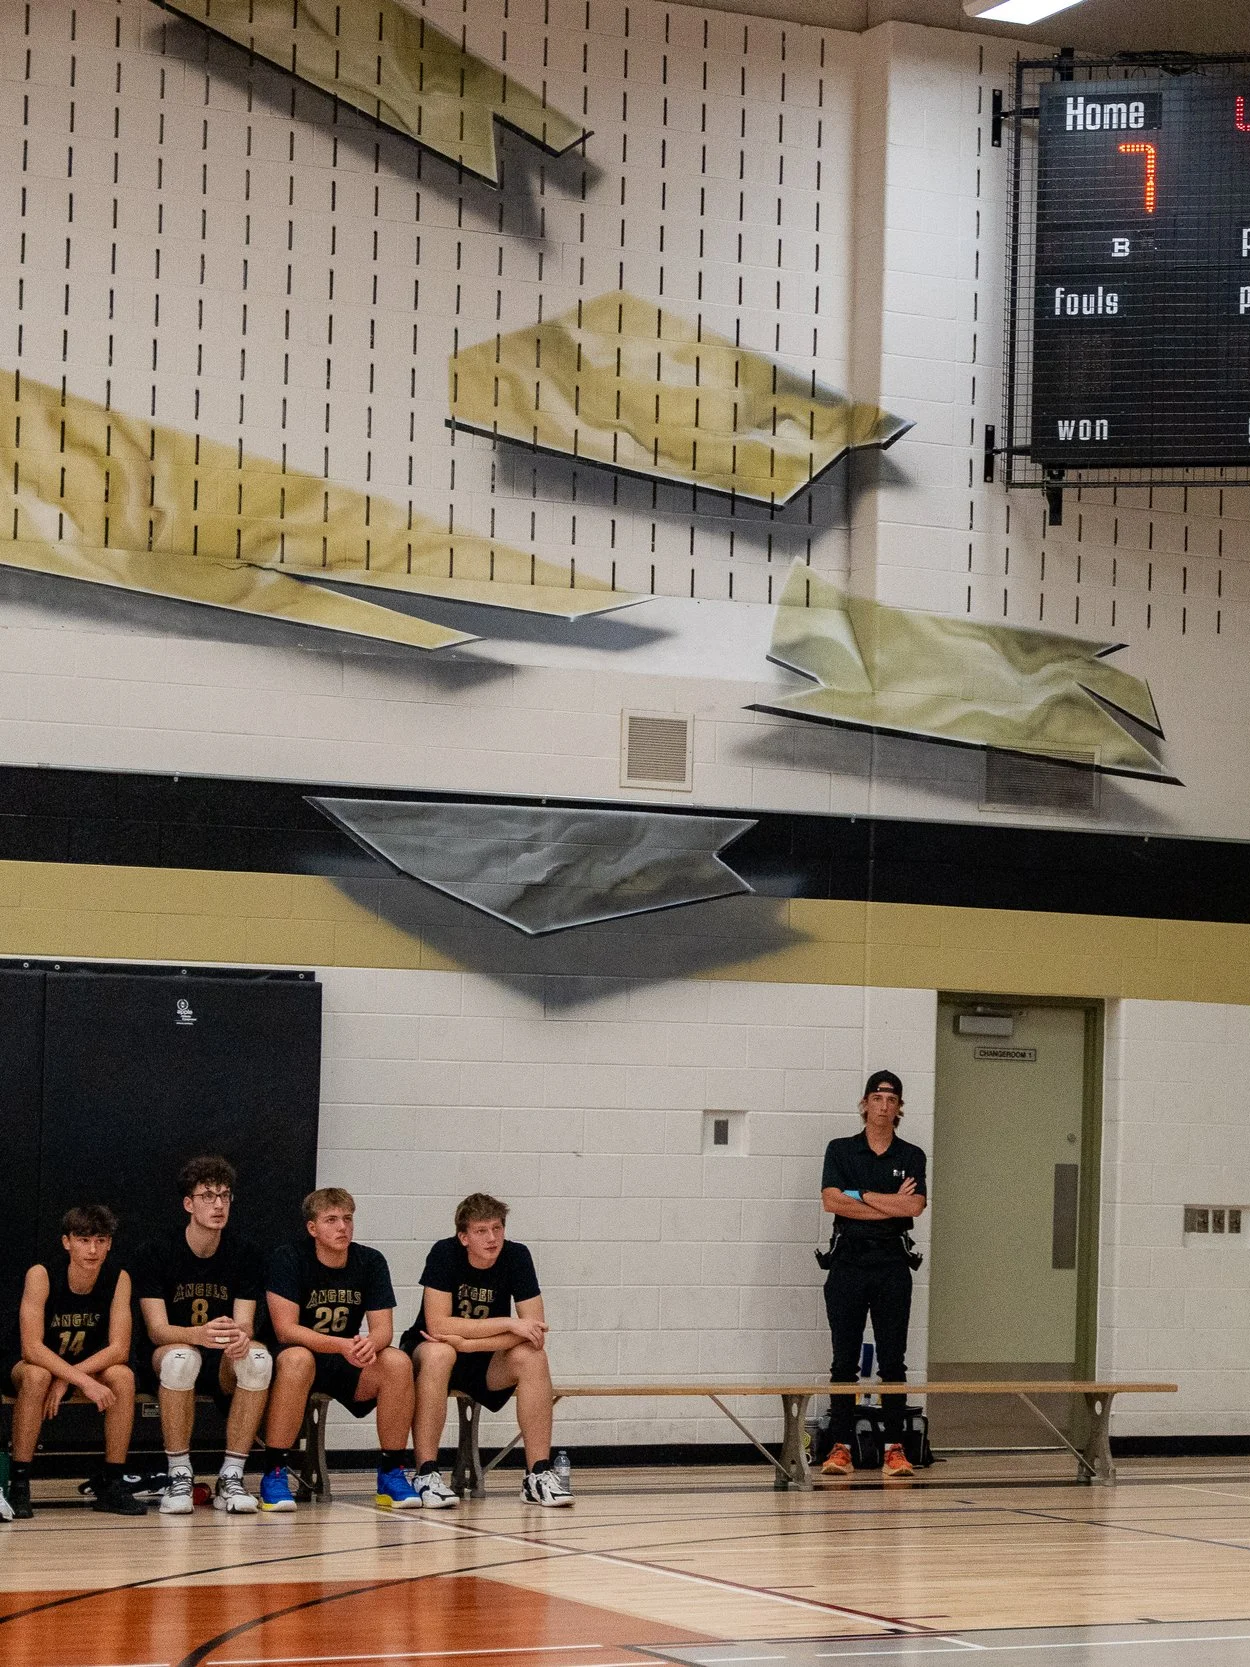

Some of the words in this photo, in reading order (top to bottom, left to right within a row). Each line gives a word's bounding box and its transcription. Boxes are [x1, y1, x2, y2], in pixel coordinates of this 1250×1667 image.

[1066, 97, 1145, 130] Home
[1118, 143, 1157, 214] 7
[1111, 238, 1130, 257] B
[1054, 287, 1120, 316] fouls
[1057, 417, 1109, 441] won
[979, 1050, 1026, 1058] CHANGEROOM
[173, 1283, 228, 1303] ANGELS
[306, 1289, 362, 1309] ANGELS
[191, 1298, 209, 1326] 8
[313, 1306, 350, 1333] 26
[58, 1330, 86, 1356] 14
